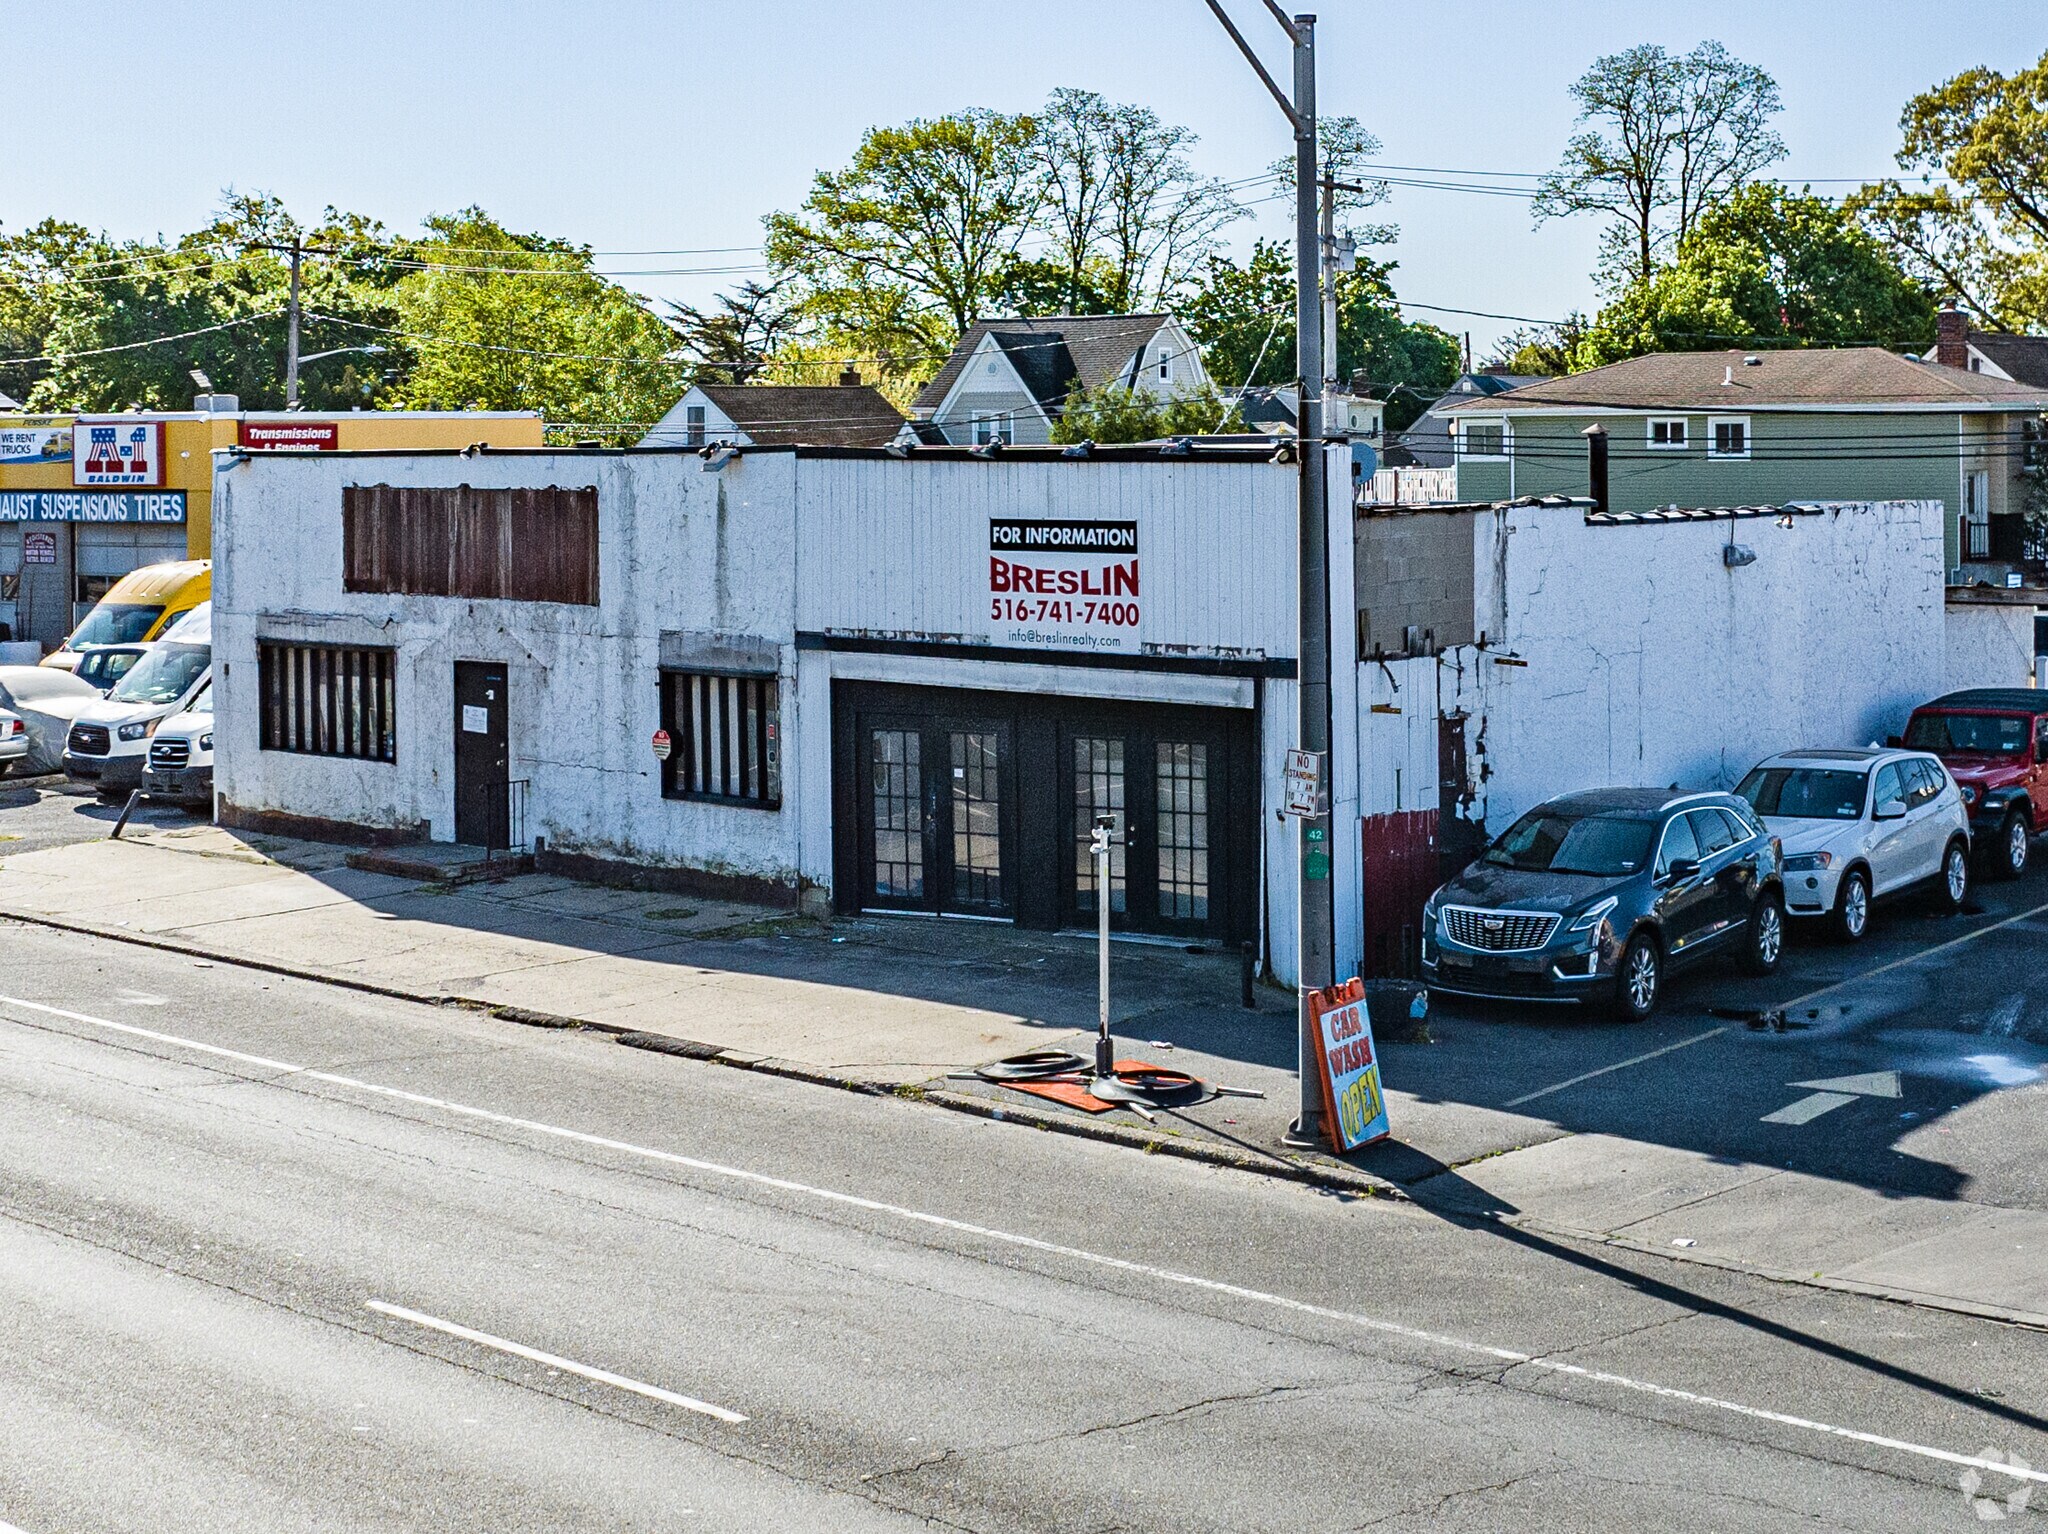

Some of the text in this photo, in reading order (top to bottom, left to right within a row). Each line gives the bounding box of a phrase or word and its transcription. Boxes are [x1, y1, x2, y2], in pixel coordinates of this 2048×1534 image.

[1, 433, 36, 443] WE RENT
[249, 428, 332, 439] Transmissions
[1, 444, 31, 454] TRUCKS
[85, 427, 147, 473] A-1
[88, 475, 145, 483] BALDWIN
[40, 494, 127, 521] SUSPENSIONS
[134, 494, 182, 521] TIRES
[992, 526, 1135, 546] FOR INFORMATION
[990, 555, 1139, 597] BRESLIN
[990, 598, 1140, 627] 516-741-7400
[1008, 628, 1121, 649] info@breslinrealty.com
[1296, 755, 1310, 769] NO
[1296, 781, 1301, 790] 7
[1287, 791, 1295, 801] TO
[1299, 793, 1304, 802] 7
[1308, 830, 1322, 840] 42
[1330, 1006, 1363, 1043] CAR
[1328, 1036, 1373, 1078] WASH
[1341, 1064, 1382, 1143] OPEN
